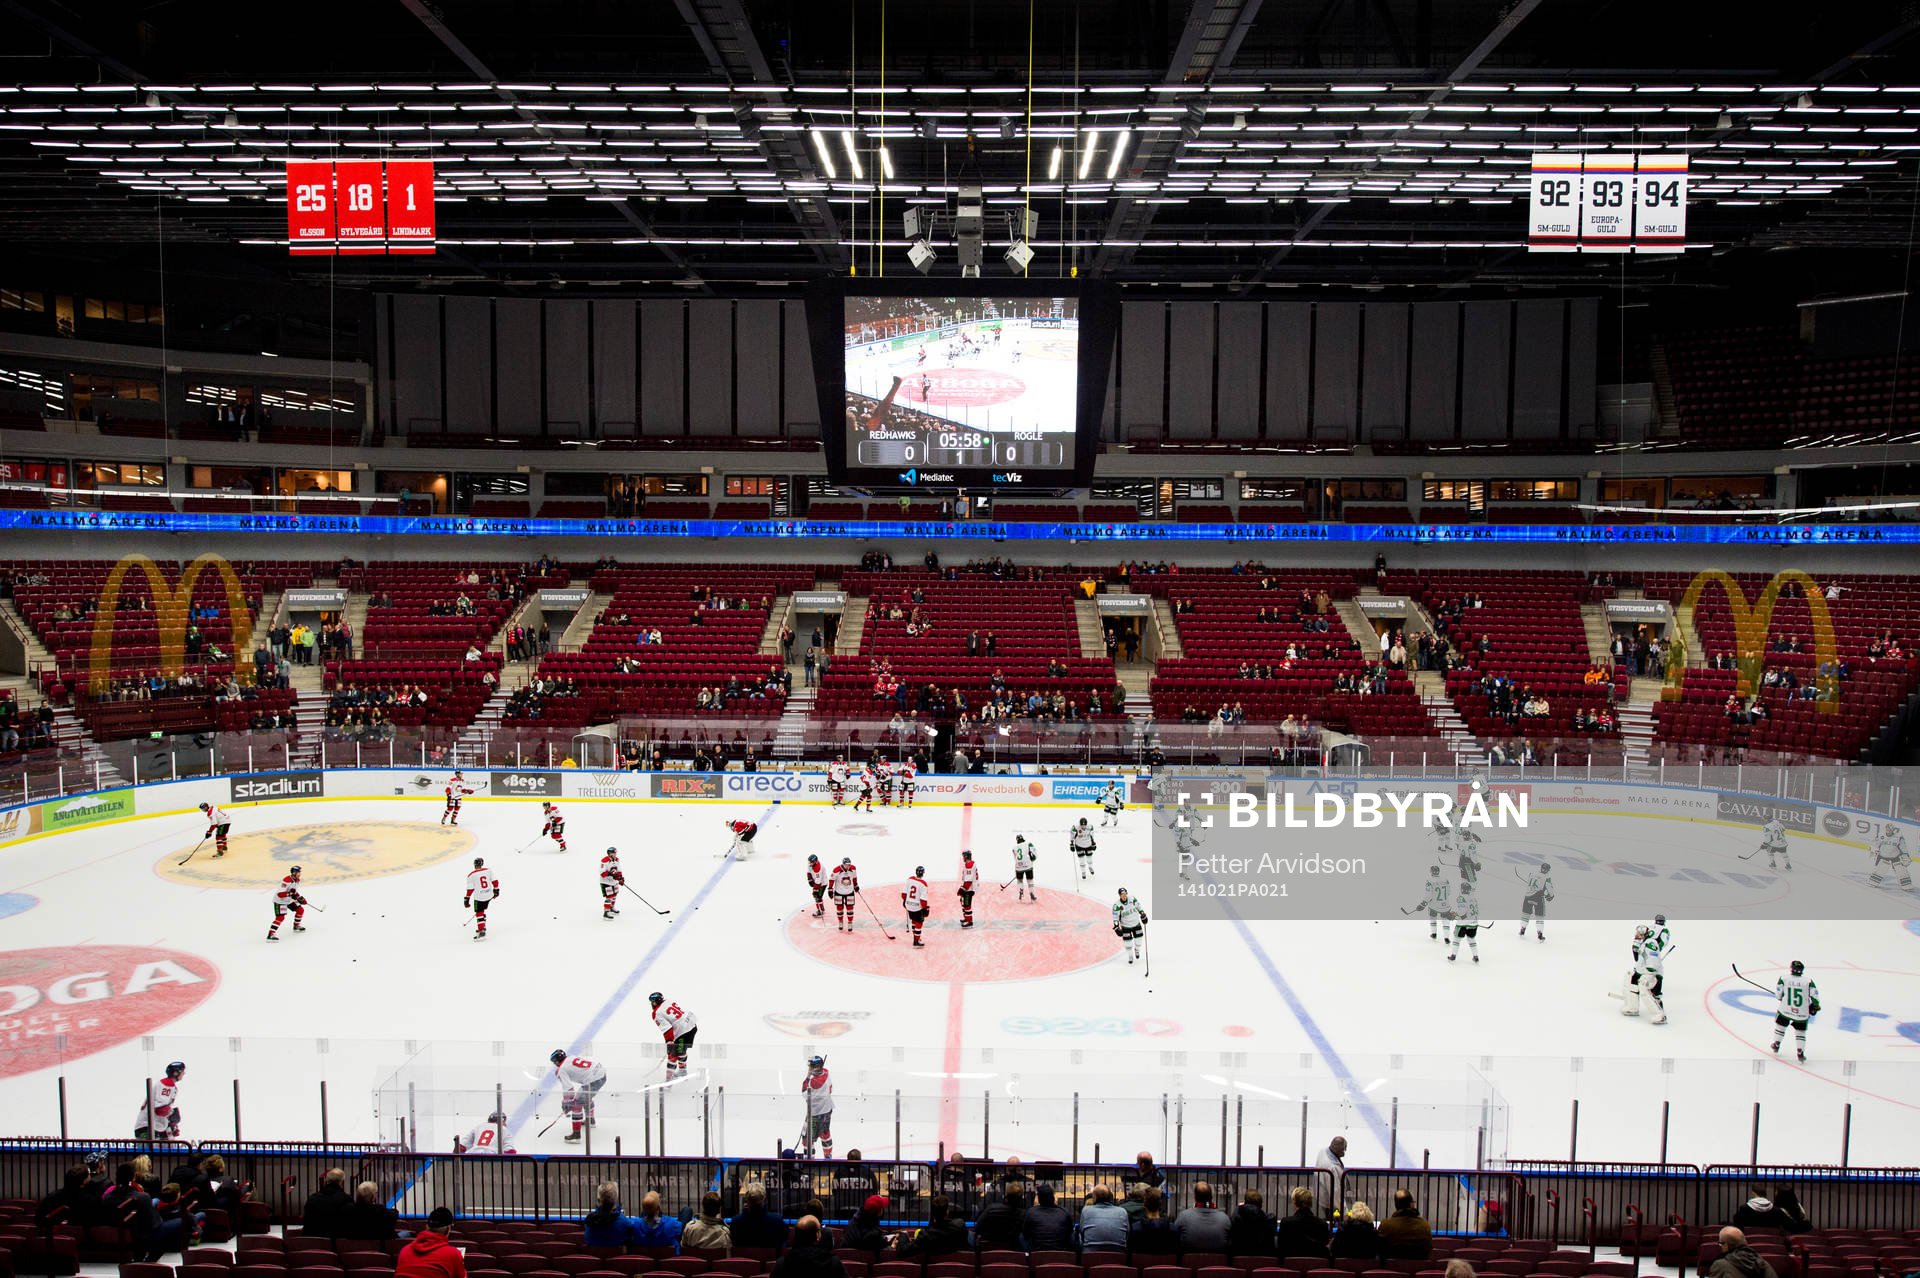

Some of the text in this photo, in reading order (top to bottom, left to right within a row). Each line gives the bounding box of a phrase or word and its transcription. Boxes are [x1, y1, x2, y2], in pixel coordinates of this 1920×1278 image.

[296, 184, 327, 212] 25
[348, 184, 373, 211] 18
[406, 183, 416, 211] 1
[1540, 180, 1571, 207] 92
[1593, 181, 1623, 208] 93
[1645, 181, 1679, 207] 94
[1591, 216, 1623, 224] EUROPA-
[392, 227, 431, 236] LINDMARK
[1537, 224, 1571, 233] SM-GULD
[1644, 224, 1678, 233] SM-GULD
[869, 431, 916, 440] REDHAWKS
[939, 433, 981, 448] 05:58
[904, 446, 915, 461] 0
[956, 451, 964, 465] 1
[1006, 447, 1016, 461] 0
[920, 472, 955, 482] Mediatec
[992, 472, 1022, 482] tecViz
[109, 517, 168, 528] ARENA
[308, 519, 359, 530] ARENA
[481, 522, 529, 532] ARENA
[642, 524, 688, 533] ARENA
[801, 525, 847, 534] ARENA
[961, 526, 1007, 536] ARENA
[1120, 527, 1166, 536] ARENA
[1281, 528, 1328, 537] ARENA
[1443, 529, 1493, 538] ARENA
[1621, 529, 1676, 540] ARENA
[1821, 530, 1883, 541] ARENA
[1360, 600, 1397, 608] YDSVENSKAN
[235, 777, 320, 797] stadium
[509, 774, 547, 790] Bege
[661, 779, 704, 793] RIX
[728, 775, 802, 792] areco
[1210, 781, 1241, 793] 300
[577, 787, 636, 798] TRELLEBORG
[973, 784, 1027, 794] Swedbank
[1628, 796, 1711, 809] MALMÖ ARENA
[1717, 802, 1812, 824] CAVALIERE
[479, 875, 488, 889] 6
[909, 885, 917, 899] 2
[1435, 886, 1447, 901] 27
[1787, 988, 1803, 1007] 15
[478, 1129, 495, 1146] 8
